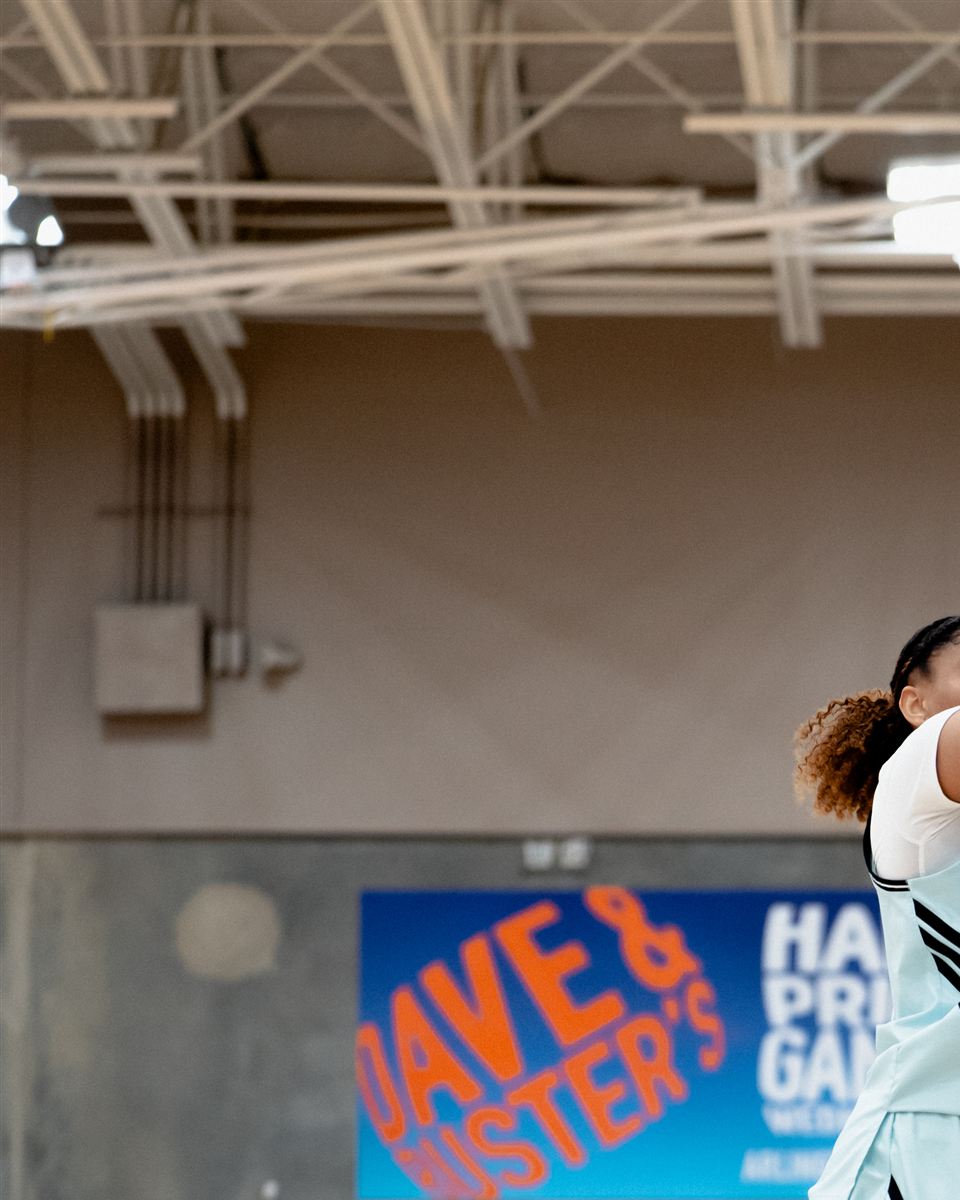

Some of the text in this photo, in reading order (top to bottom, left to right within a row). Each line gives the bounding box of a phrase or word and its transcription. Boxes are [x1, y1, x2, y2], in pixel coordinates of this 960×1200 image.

[584, 884, 702, 991] &
[762, 902, 886, 974] HA
[764, 974, 893, 1027] PRI
